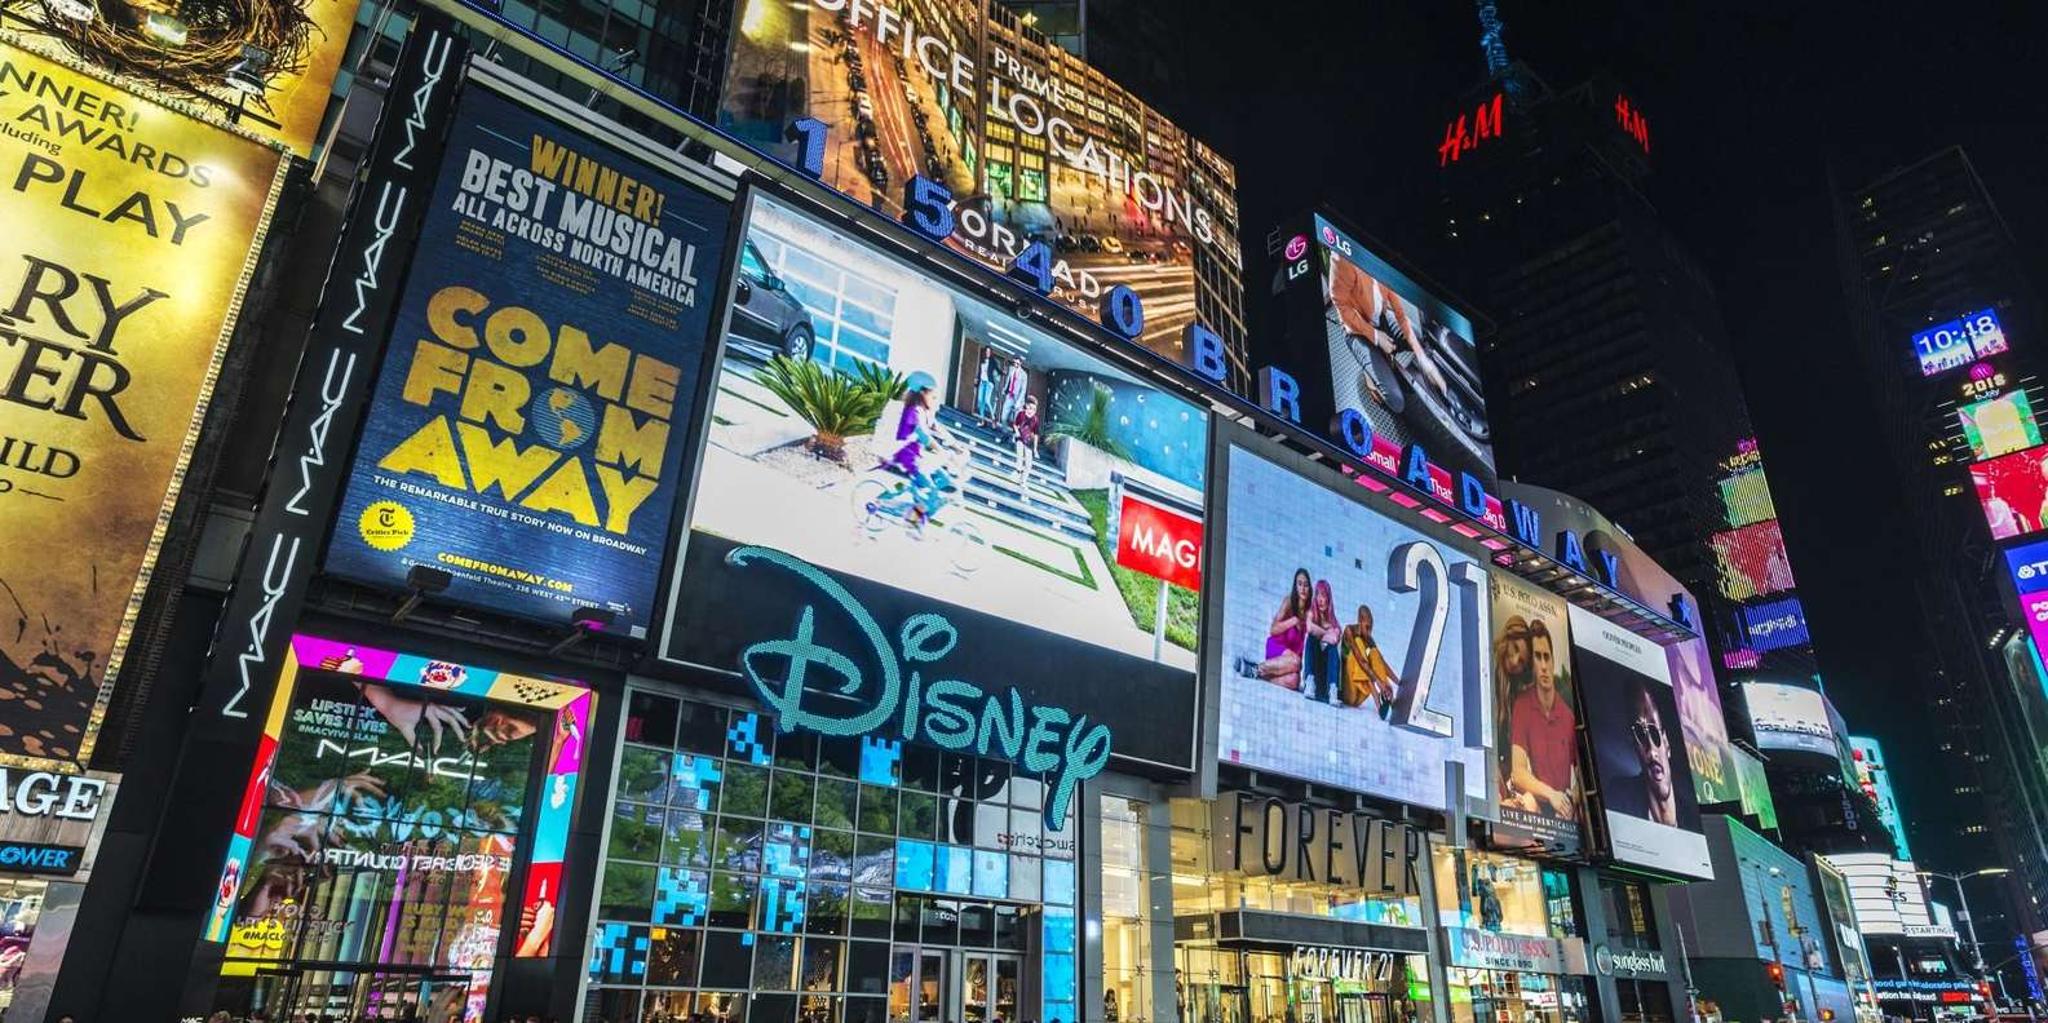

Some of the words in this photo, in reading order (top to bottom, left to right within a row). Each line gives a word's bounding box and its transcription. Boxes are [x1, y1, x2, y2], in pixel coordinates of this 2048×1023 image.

[815, 0, 975, 99] FFICE
[994, 46, 1068, 111] PRIME
[0, 121, 63, 157] luding
[16, 103, 213, 189] AWARDS
[991, 76, 1213, 246] LOCATIONS
[1439, 93, 1503, 167] H&M
[1615, 93, 1650, 153] H&M
[13, 152, 211, 246] PLAY
[460, 148, 556, 221] BEST
[558, 191, 698, 286] MUSICAL
[530, 133, 665, 227] WINNER!
[452, 192, 487, 223] ALL
[492, 207, 566, 253] ACROSS
[569, 240, 623, 278] NORTH
[625, 264, 696, 308] AMERICA
[947, 199, 1114, 300] ORAD
[1289, 260, 1310, 281] LG
[1336, 236, 1353, 257] LG
[1053, 286, 1100, 315] RUST
[1919, 315, 1997, 354] 10:48
[0, 329, 147, 442] ER
[427, 286, 682, 420] COME
[1962, 373, 2006, 397] 2018
[403, 339, 671, 481] FROM
[377, 414, 659, 536] AWAY
[373, 474, 397, 489] THE
[400, 481, 477, 511] REMARKABLE
[480, 503, 508, 518] TRUE
[511, 511, 546, 530] STORY
[548, 521, 573, 535] NOW
[575, 528, 591, 540] ON
[592, 534, 648, 556] BROADWAY
[437, 553, 573, 593] COMEFROMAWAY.COM
[1388, 540, 1493, 749] 21
[293, 708, 344, 729] SAVES
[1233, 790, 1423, 896] FOREVER
[1502, 809, 1521, 820] LIVE
[1293, 946, 1373, 980] FOREVER
[1375, 953, 1394, 981] 21
[1485, 956, 1510, 967] SINCE
[1611, 950, 1650, 976] sunglass
